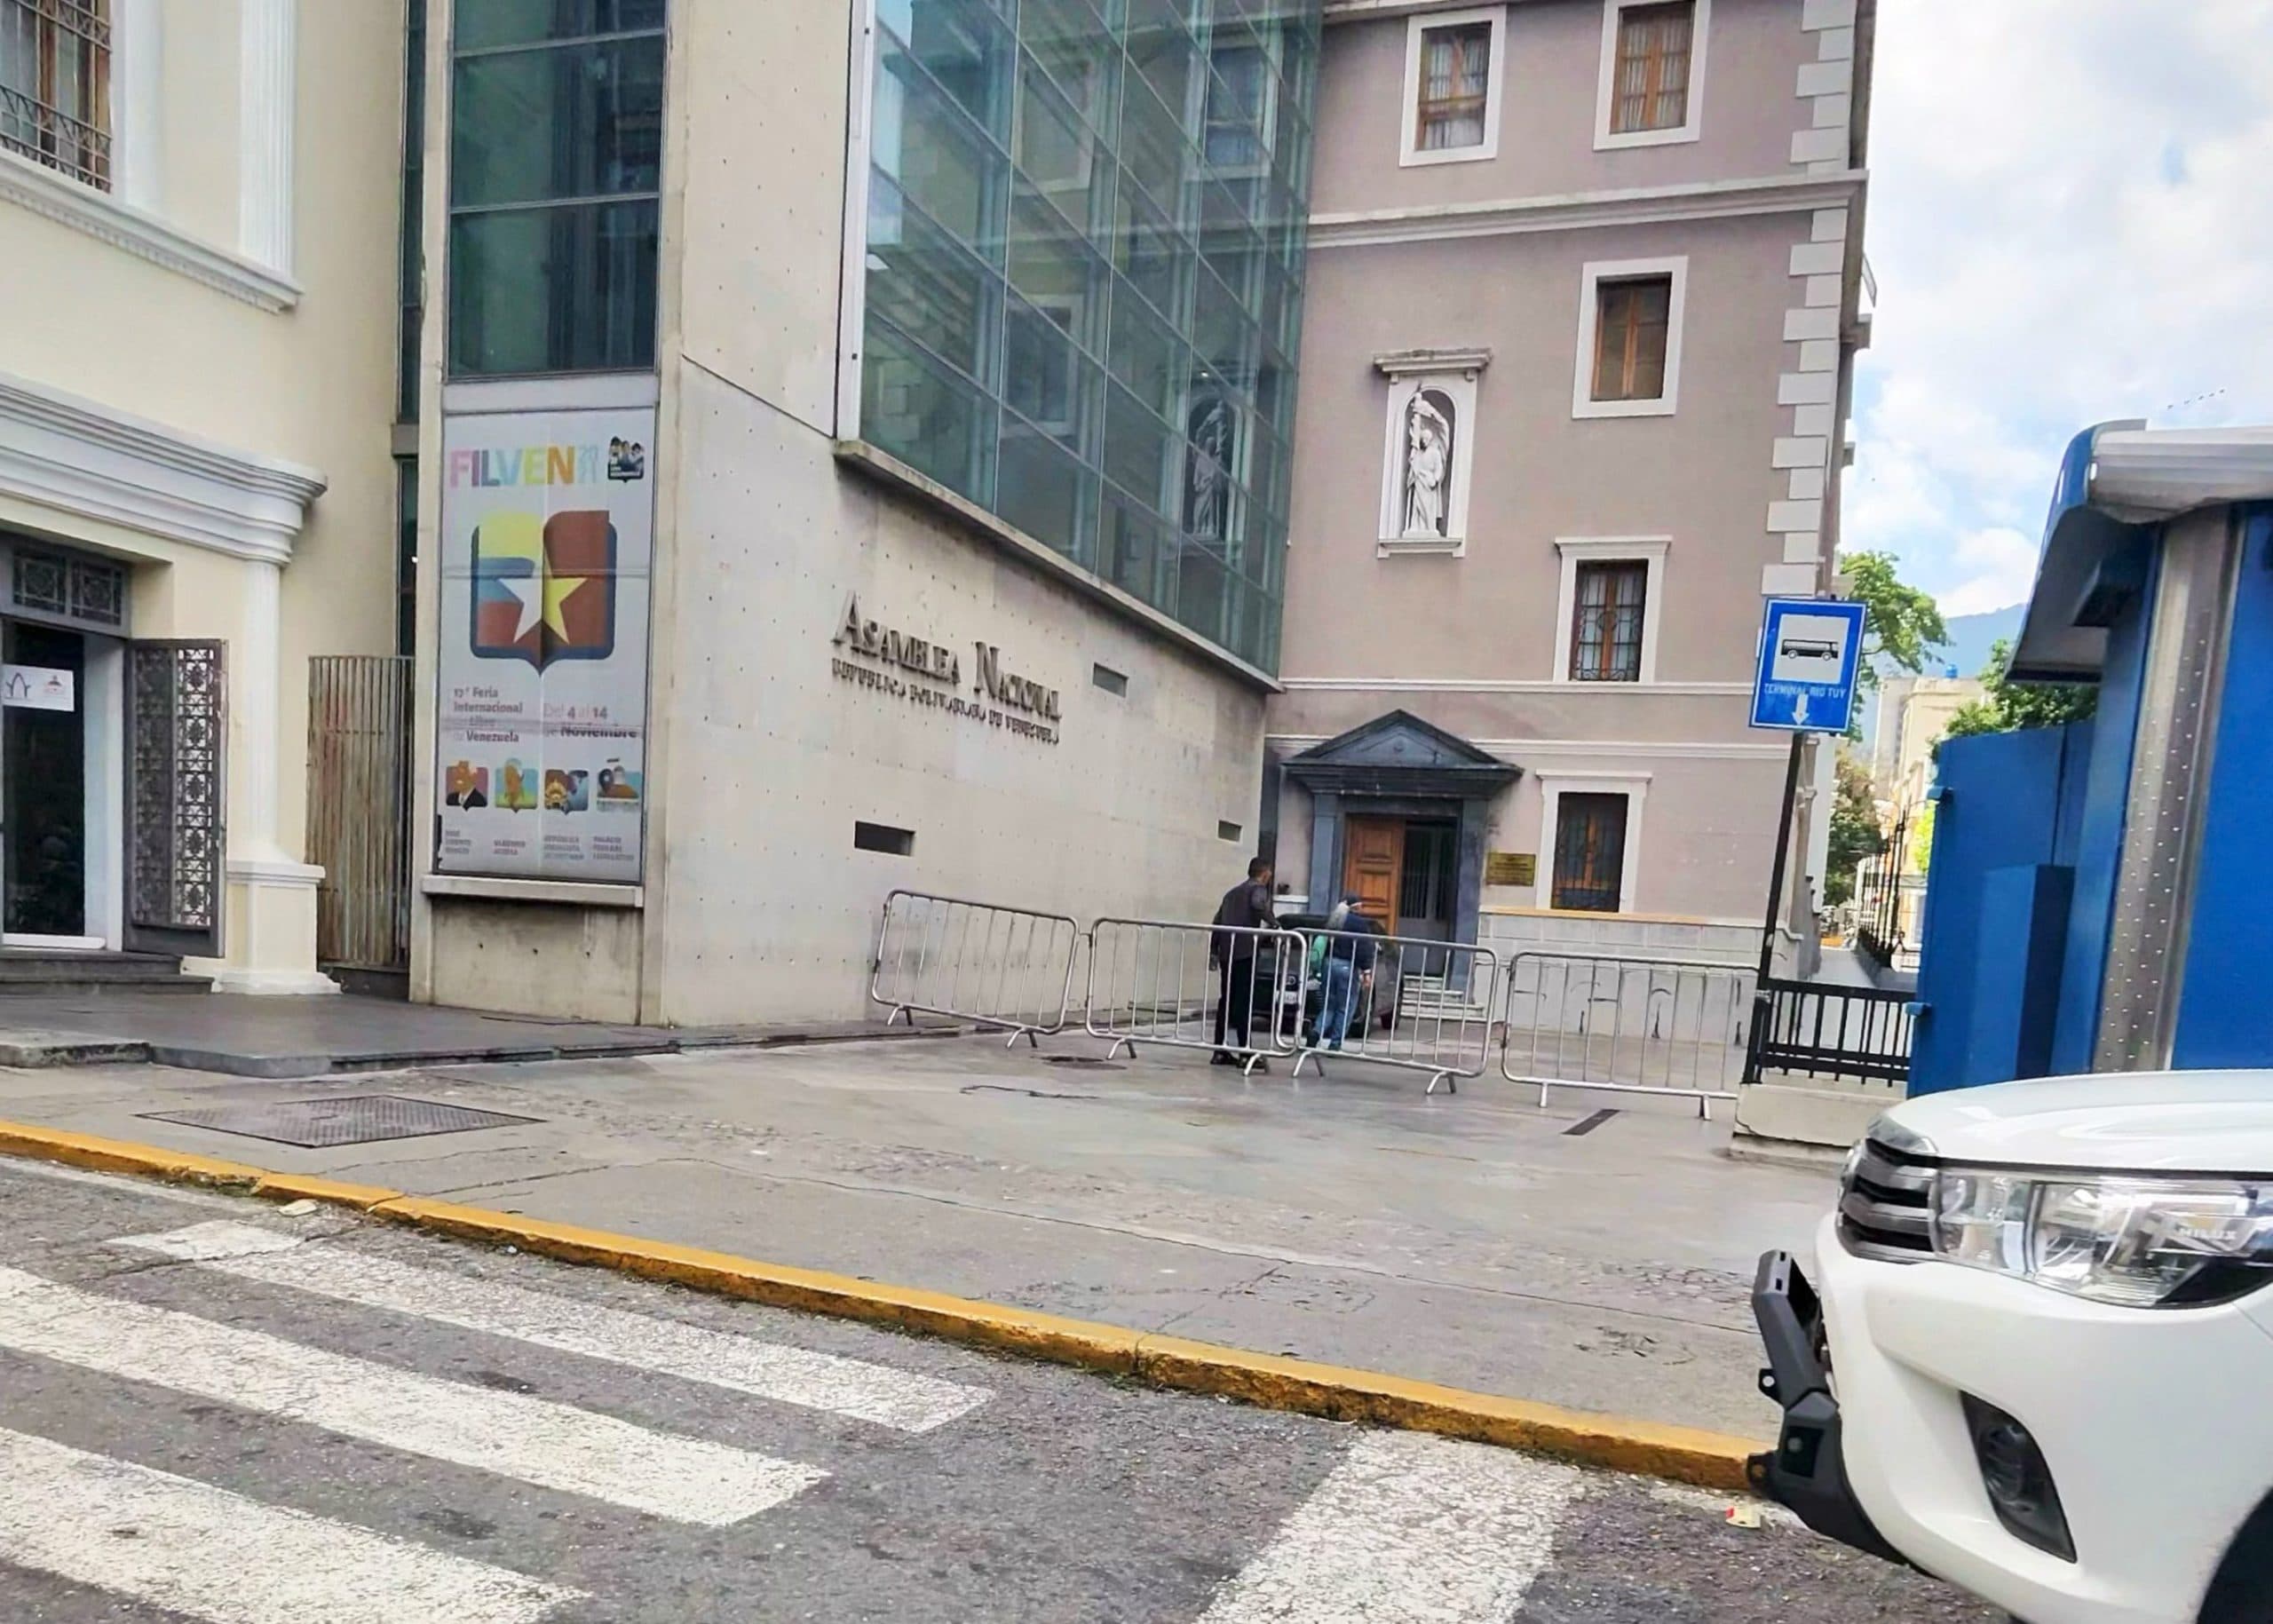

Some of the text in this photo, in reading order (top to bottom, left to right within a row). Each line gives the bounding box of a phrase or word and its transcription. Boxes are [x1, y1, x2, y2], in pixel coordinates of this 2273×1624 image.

[450, 446, 575, 487] FILVEN
[831, 590, 961, 685] ASAMBLEA
[472, 685, 498, 698] Feria
[1828, 687, 1848, 699] TUY
[454, 701, 523, 714] Internacional
[567, 706, 576, 719] 4
[593, 706, 608, 720] 14
[466, 729, 519, 743] Venezuela
